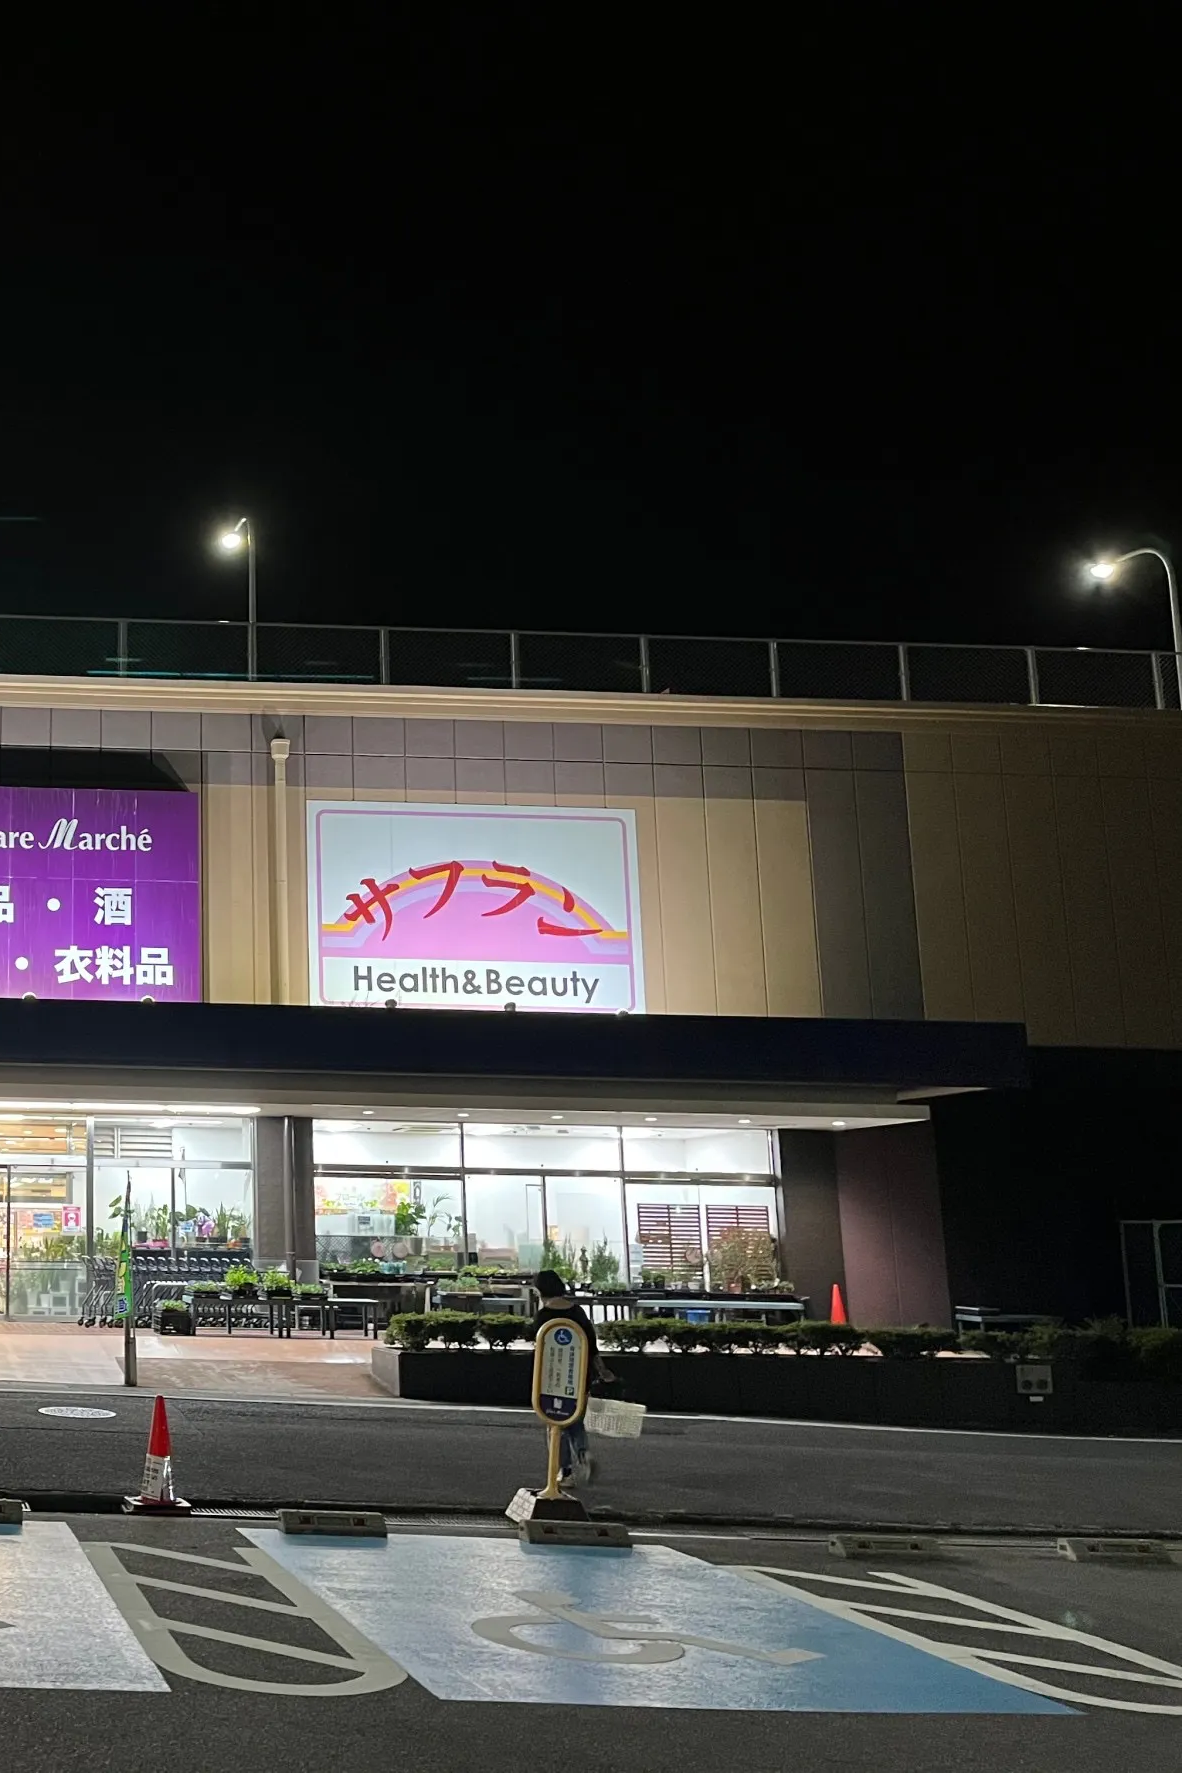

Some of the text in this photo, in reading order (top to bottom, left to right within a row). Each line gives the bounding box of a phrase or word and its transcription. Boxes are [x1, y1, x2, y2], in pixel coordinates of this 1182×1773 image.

[38, 818, 153, 852] Marché
[344, 860, 603, 942] サフラン
[353, 965, 600, 1003] Health&Beauty
